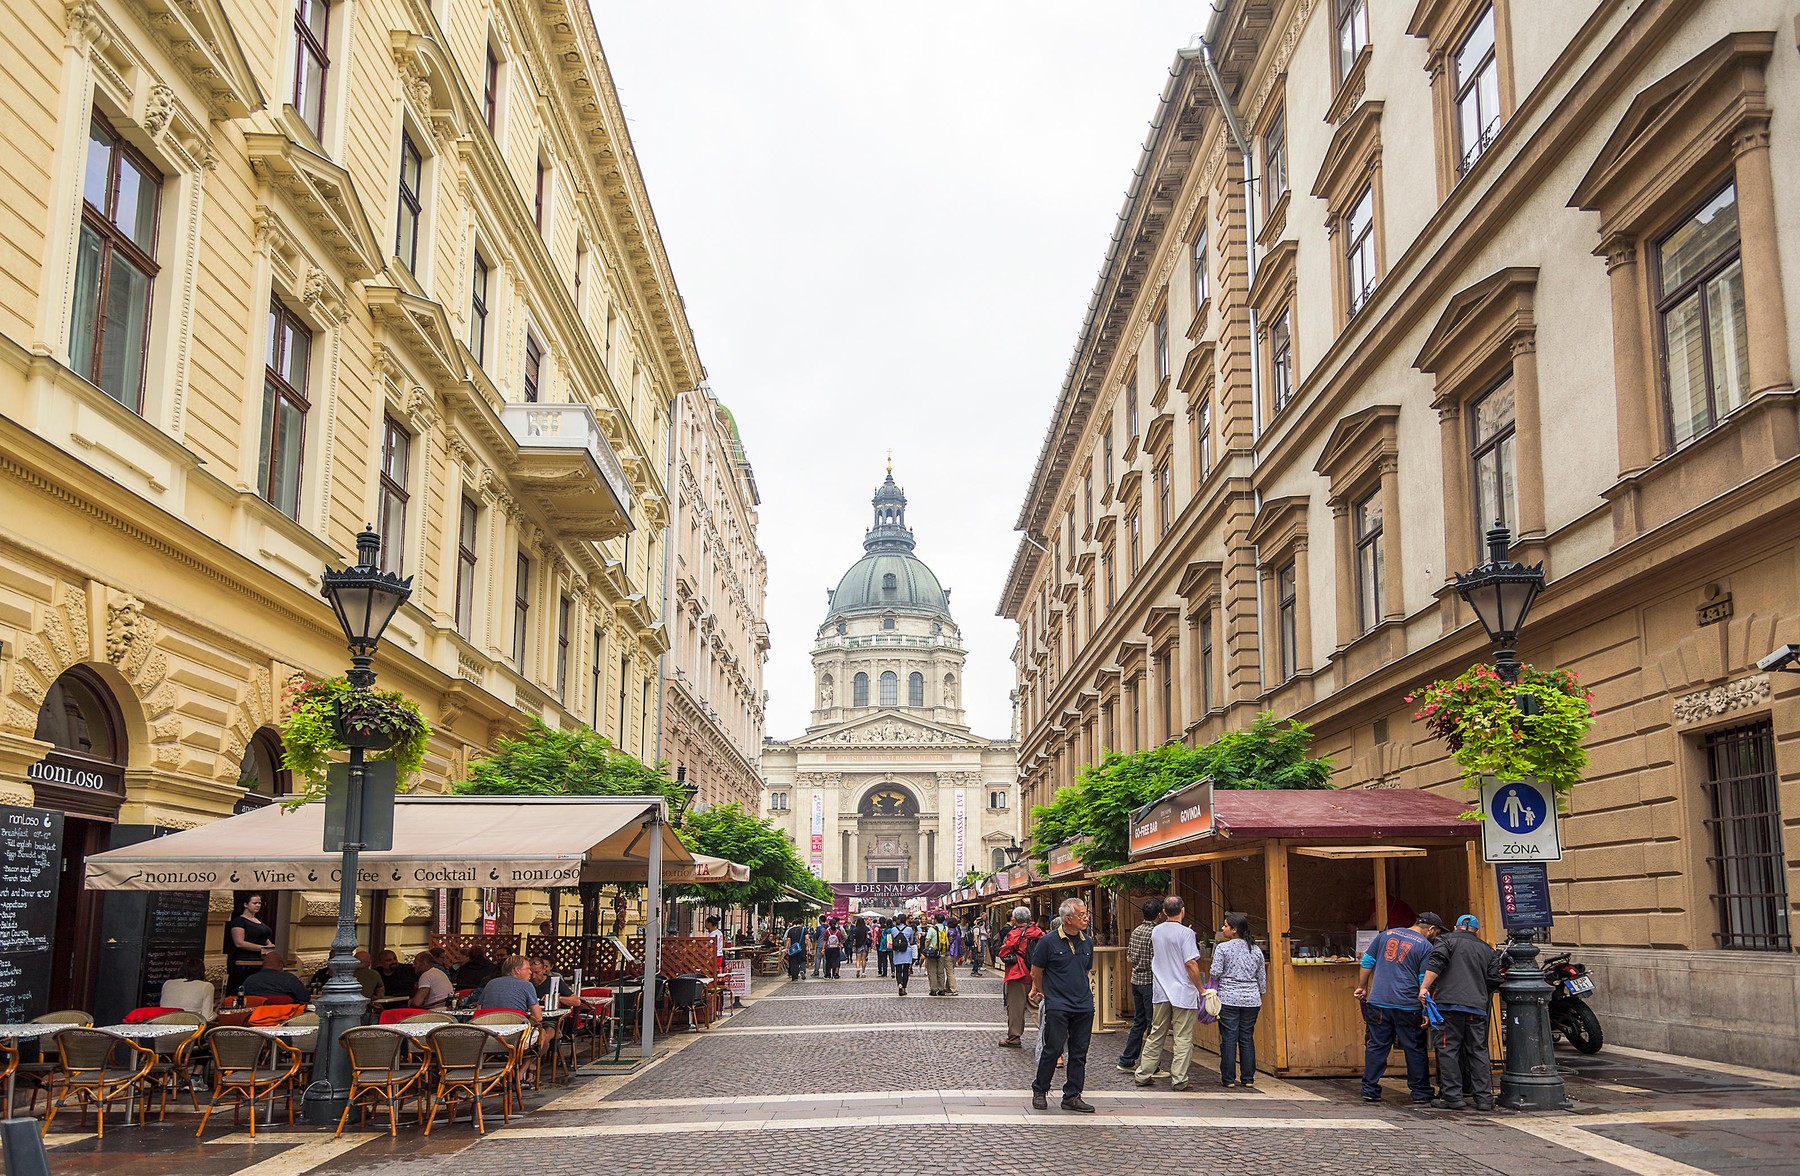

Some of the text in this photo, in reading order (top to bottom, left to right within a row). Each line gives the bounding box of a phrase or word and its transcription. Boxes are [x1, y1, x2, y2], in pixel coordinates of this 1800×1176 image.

[1180, 804, 1202, 823] GOVINDA
[1, 827, 29, 839] Breakfast
[1149, 821, 1158, 834] BAR
[1503, 841, 1540, 855] ZÓNA
[254, 869, 296, 883] Wine
[330, 868, 380, 882] Cfee
[414, 867, 477, 882] Cocktail
[854, 883, 881, 893] ÉDES
[1384, 937, 1413, 965] 97
